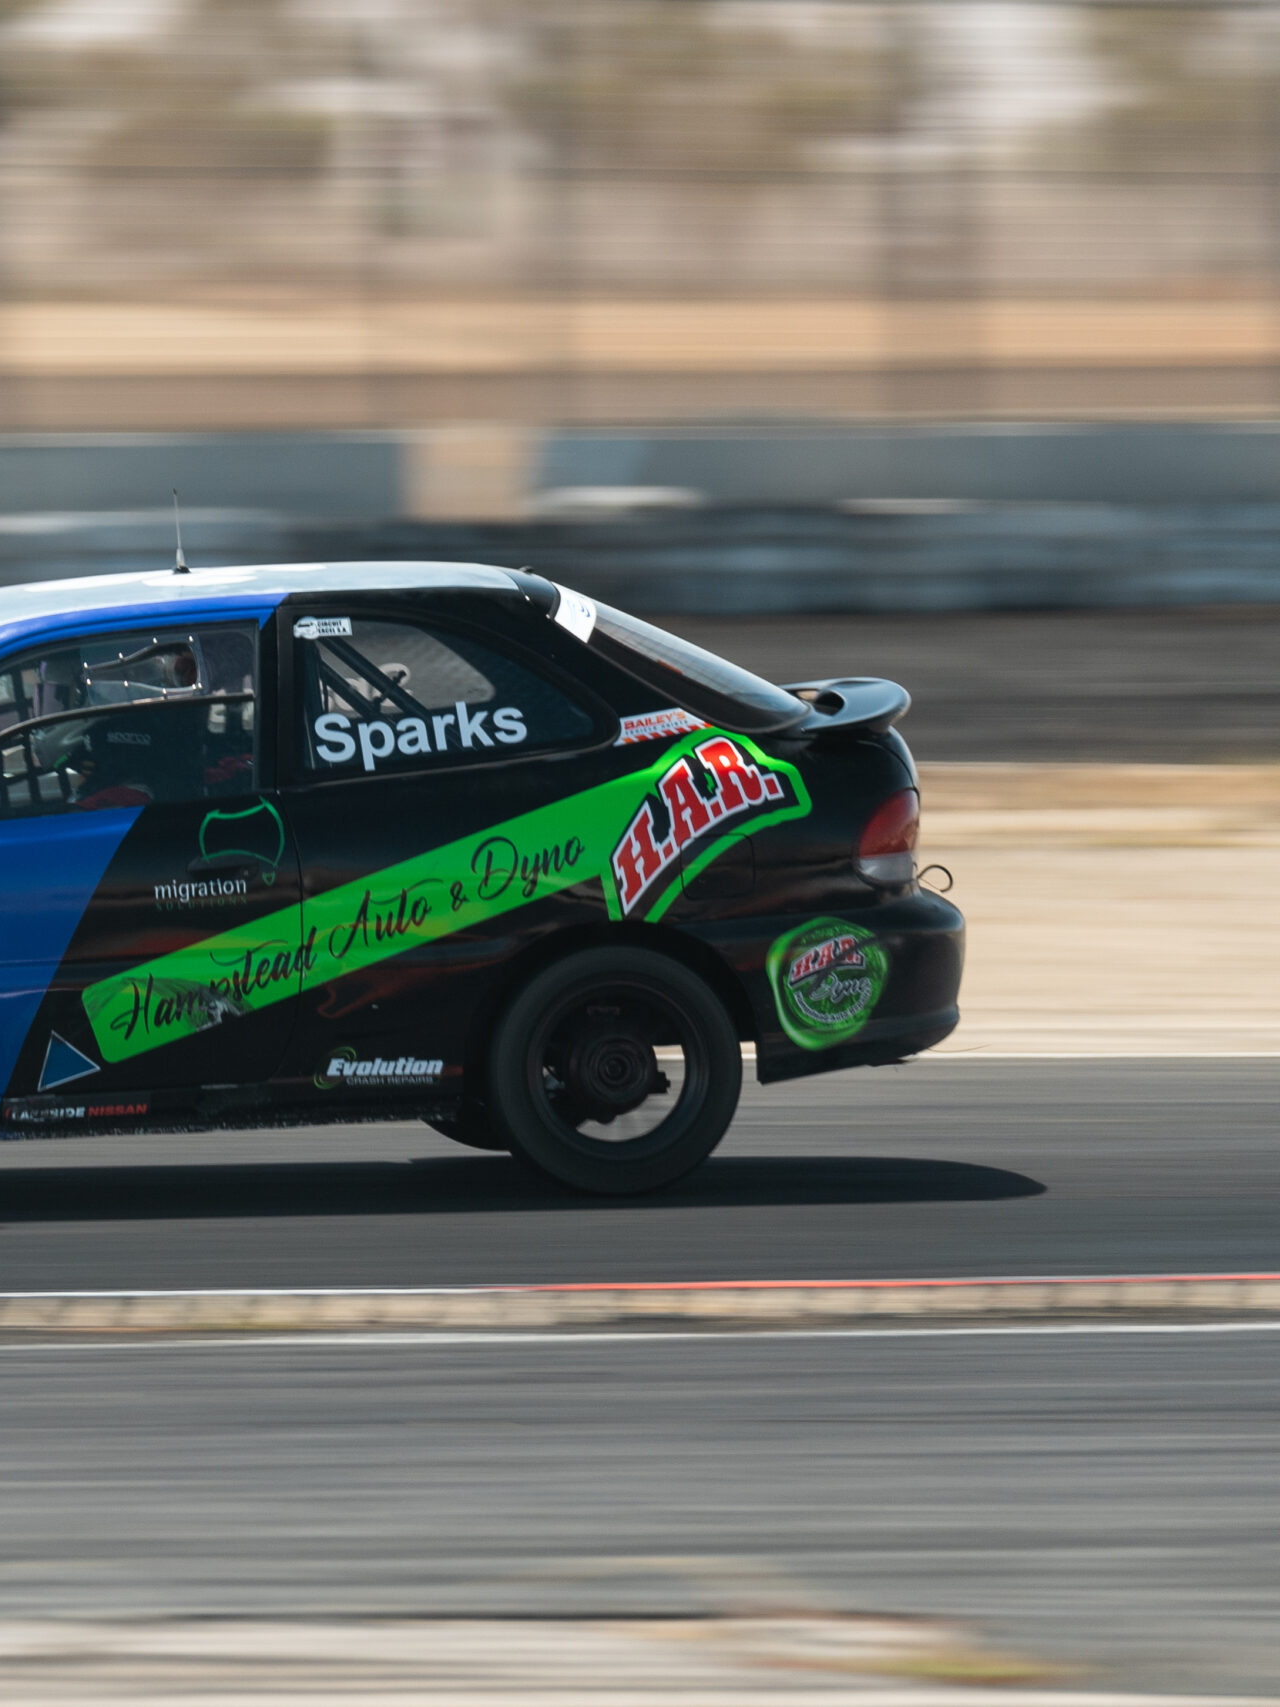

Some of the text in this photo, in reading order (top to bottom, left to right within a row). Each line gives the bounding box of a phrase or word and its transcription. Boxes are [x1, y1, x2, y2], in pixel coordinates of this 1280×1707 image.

[624, 711, 687, 730] BAILEY'S
[314, 701, 528, 771] Sparks
[613, 735, 785, 915] H.A.R.
[153, 878, 247, 904] migration
[328, 878, 444, 960] Auto
[449, 879, 471, 914] &
[470, 835, 585, 903] Dyno
[327, 1057, 444, 1077] Evolution
[346, 1076, 385, 1086] CRASH
[88, 1103, 148, 1117] NISSAN
